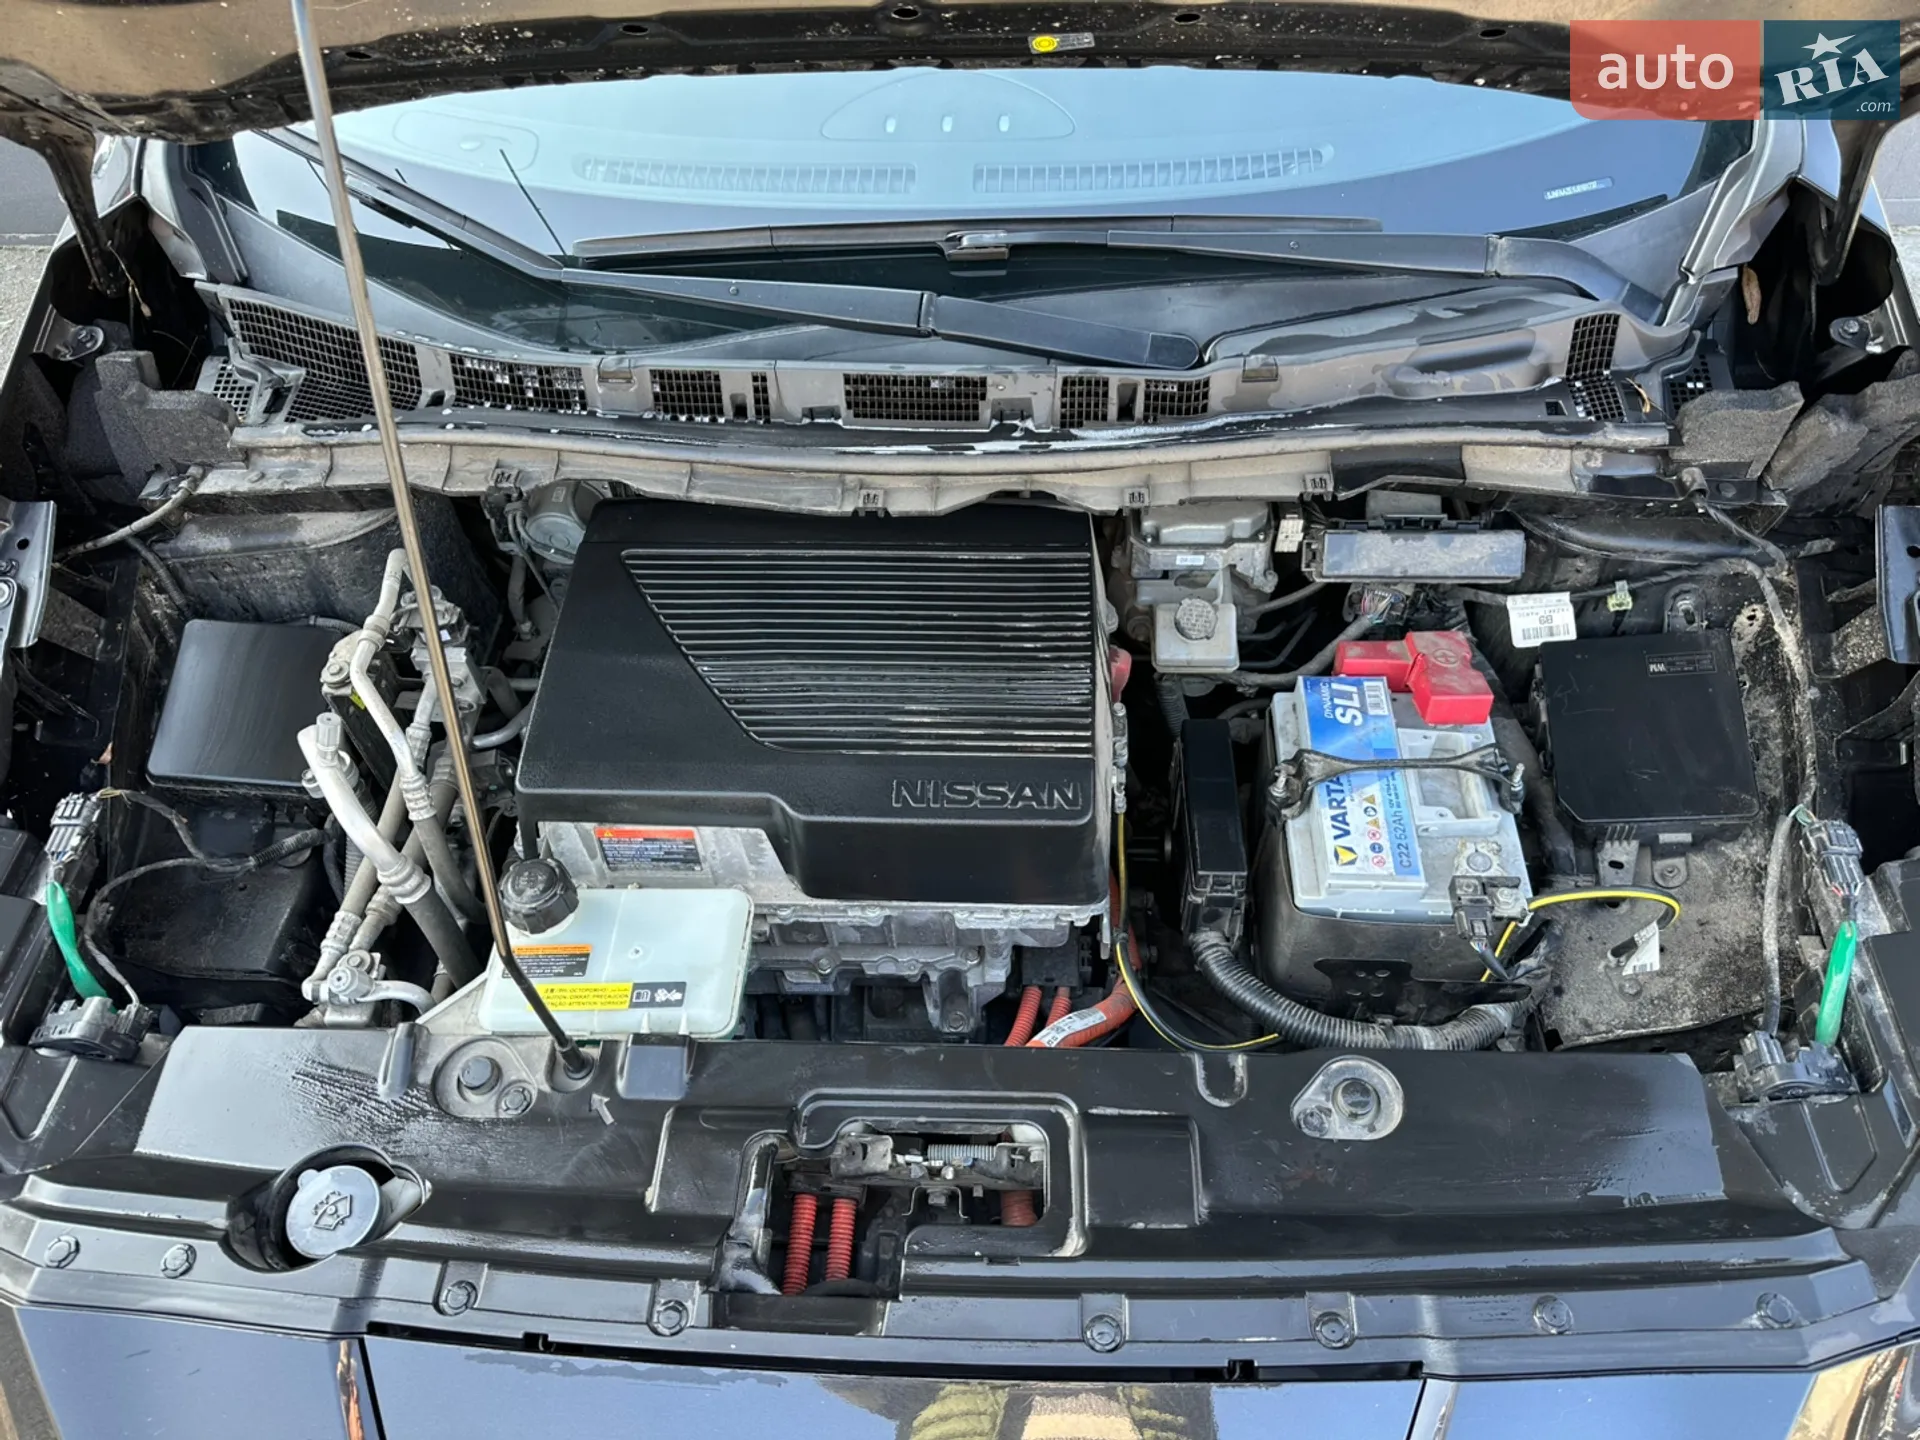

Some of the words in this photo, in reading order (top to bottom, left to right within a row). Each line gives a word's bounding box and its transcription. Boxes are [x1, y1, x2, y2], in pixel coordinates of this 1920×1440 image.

[1320, 681, 1334, 719] DYNAMIC
[1330, 682, 1363, 726] SLI
[892, 779, 1082, 810] NISSAN
[1326, 775, 1351, 840] VARTA
[1391, 810, 1408, 841] 52Ah
[1397, 842, 1412, 868] C22
